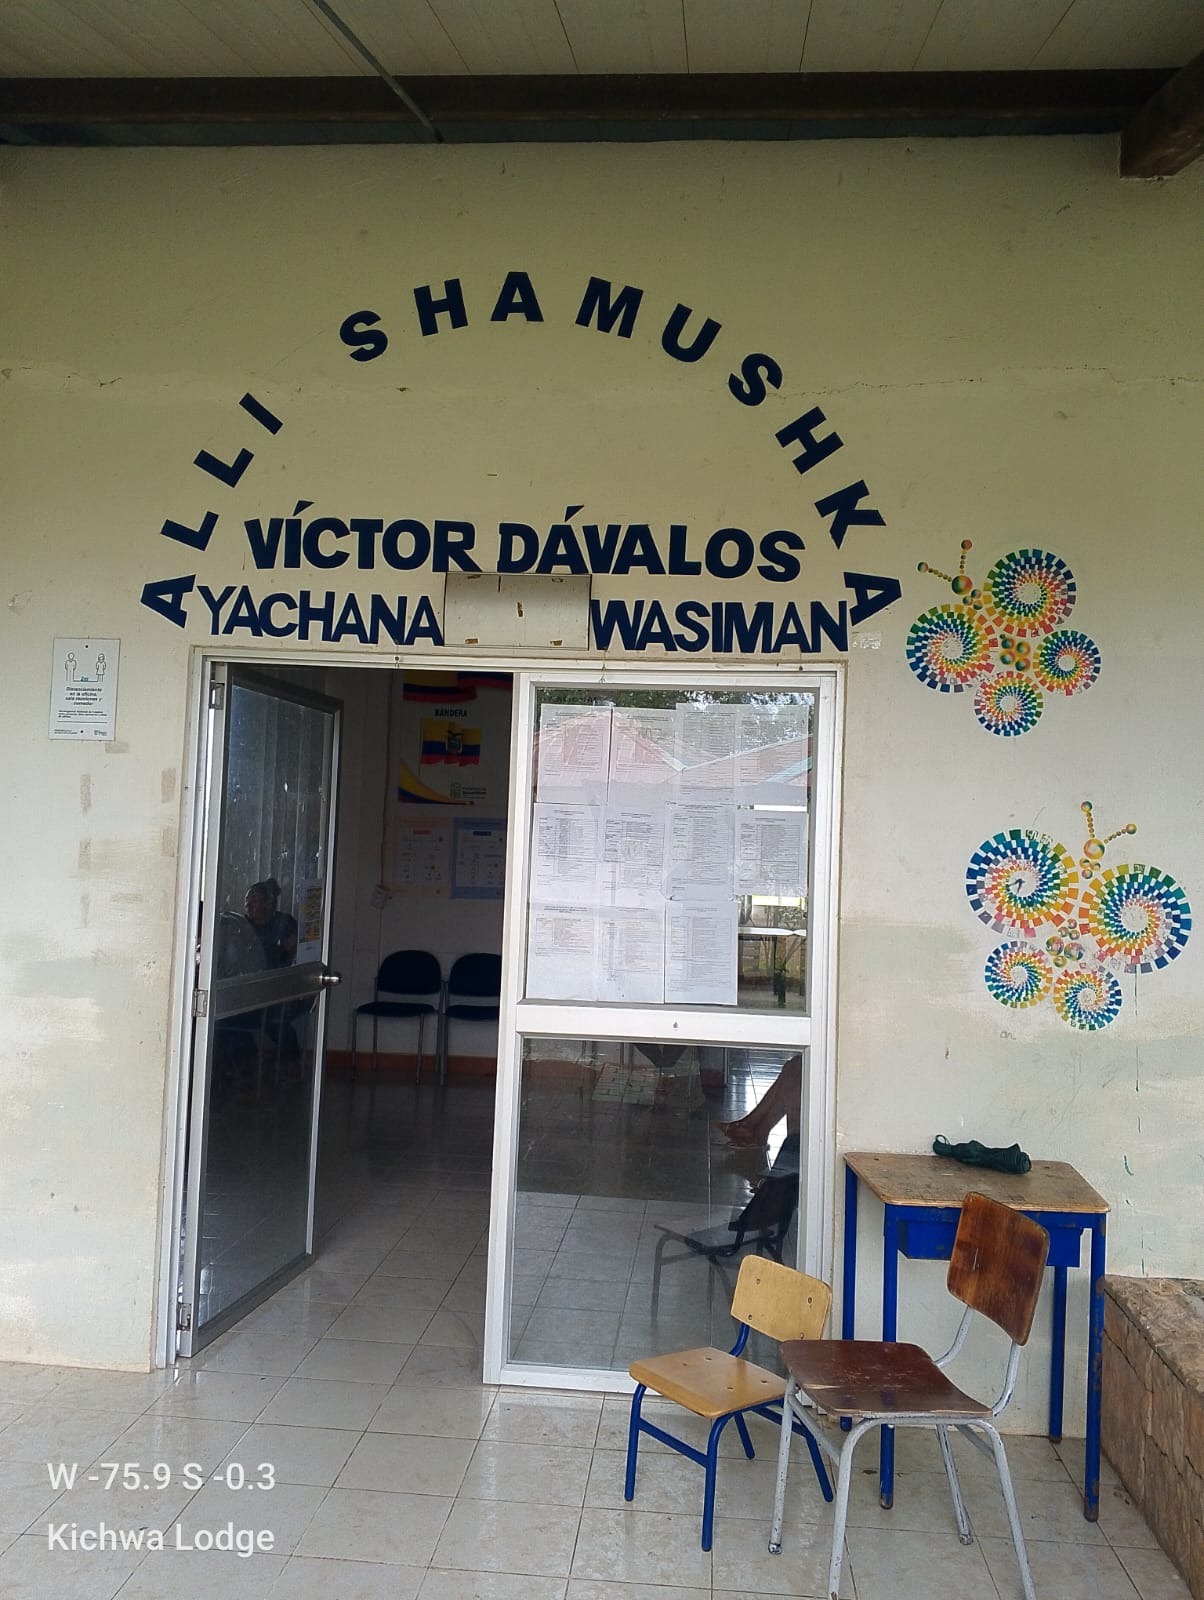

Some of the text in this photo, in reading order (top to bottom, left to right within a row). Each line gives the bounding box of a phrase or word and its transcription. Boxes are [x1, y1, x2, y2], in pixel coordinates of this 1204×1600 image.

[140, 271, 903, 629] ALLI SHAMUSHKA
[245, 500, 806, 582] VÍCTOR DÁVALOS
[197, 585, 849, 653] YACHANA WASIMAN
